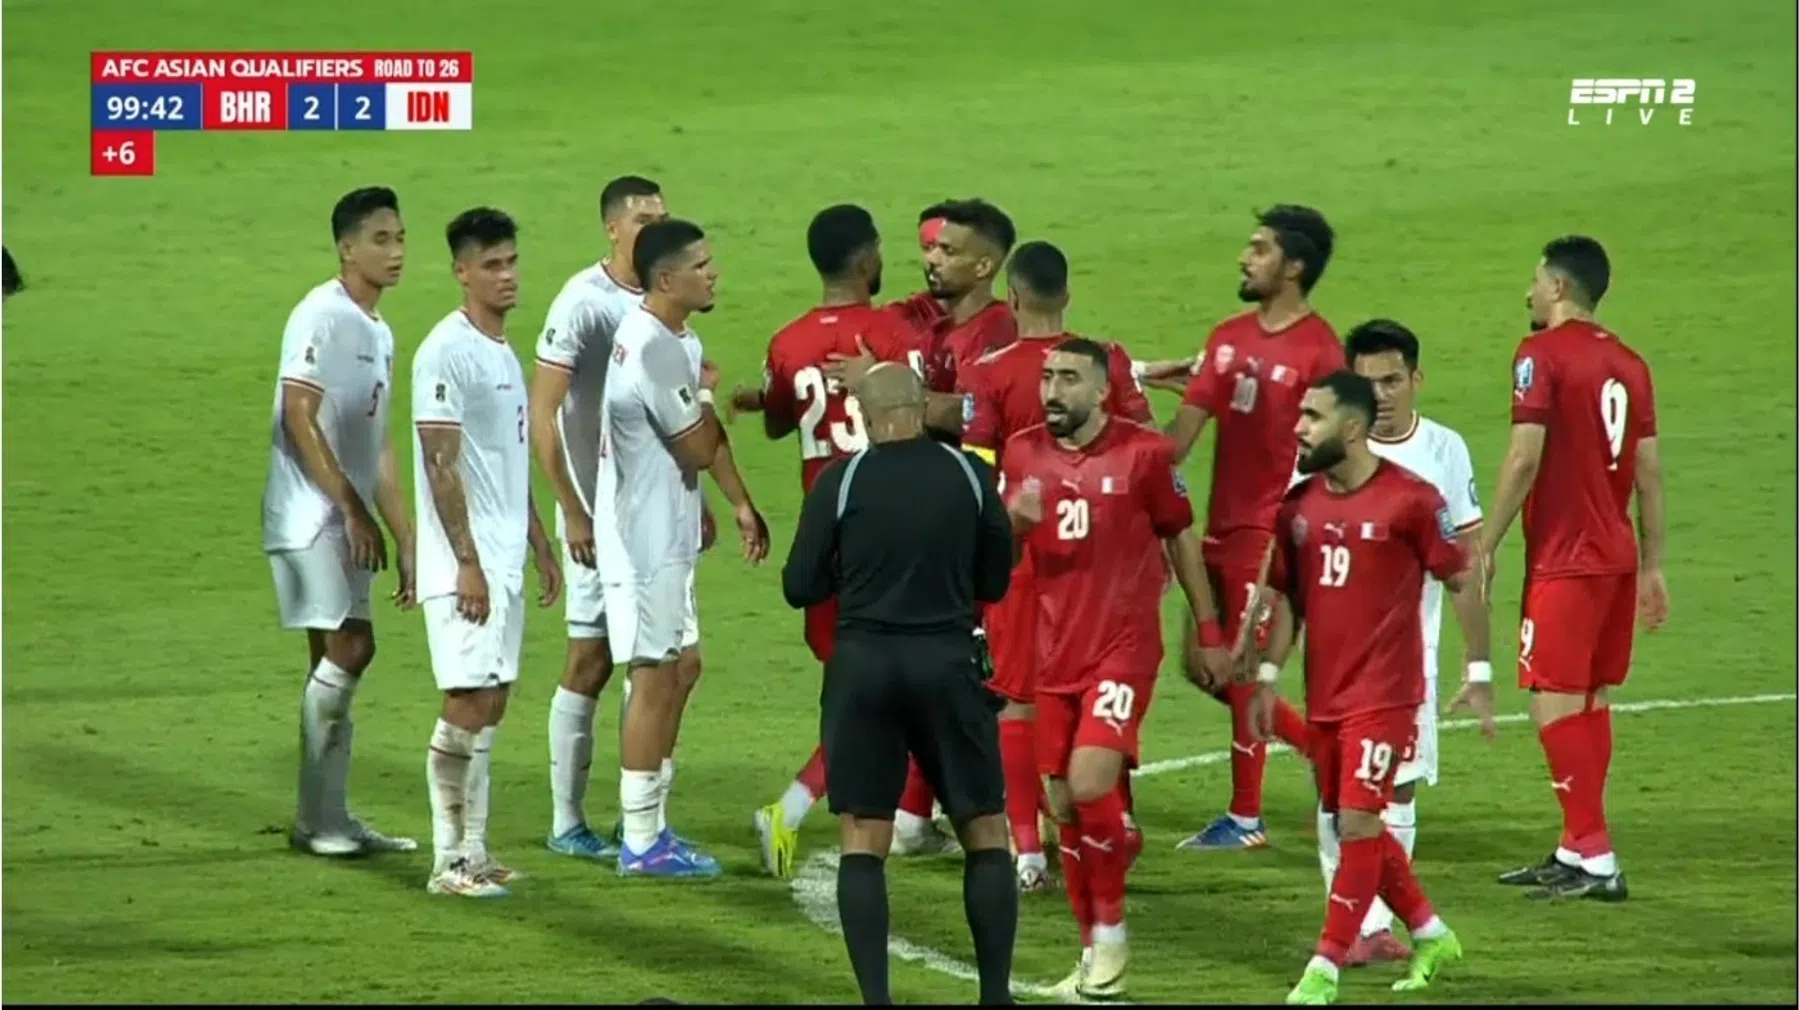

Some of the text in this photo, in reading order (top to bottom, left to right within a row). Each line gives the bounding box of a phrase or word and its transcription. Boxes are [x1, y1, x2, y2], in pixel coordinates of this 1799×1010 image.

[794, 366, 870, 460] 23
[1600, 377, 1628, 470] 9
[1056, 498, 1089, 540] 20
[1319, 544, 1351, 588] 19
[1520, 616, 1535, 657] 9
[1092, 679, 1135, 720] 20
[1355, 737, 1393, 781] 19
